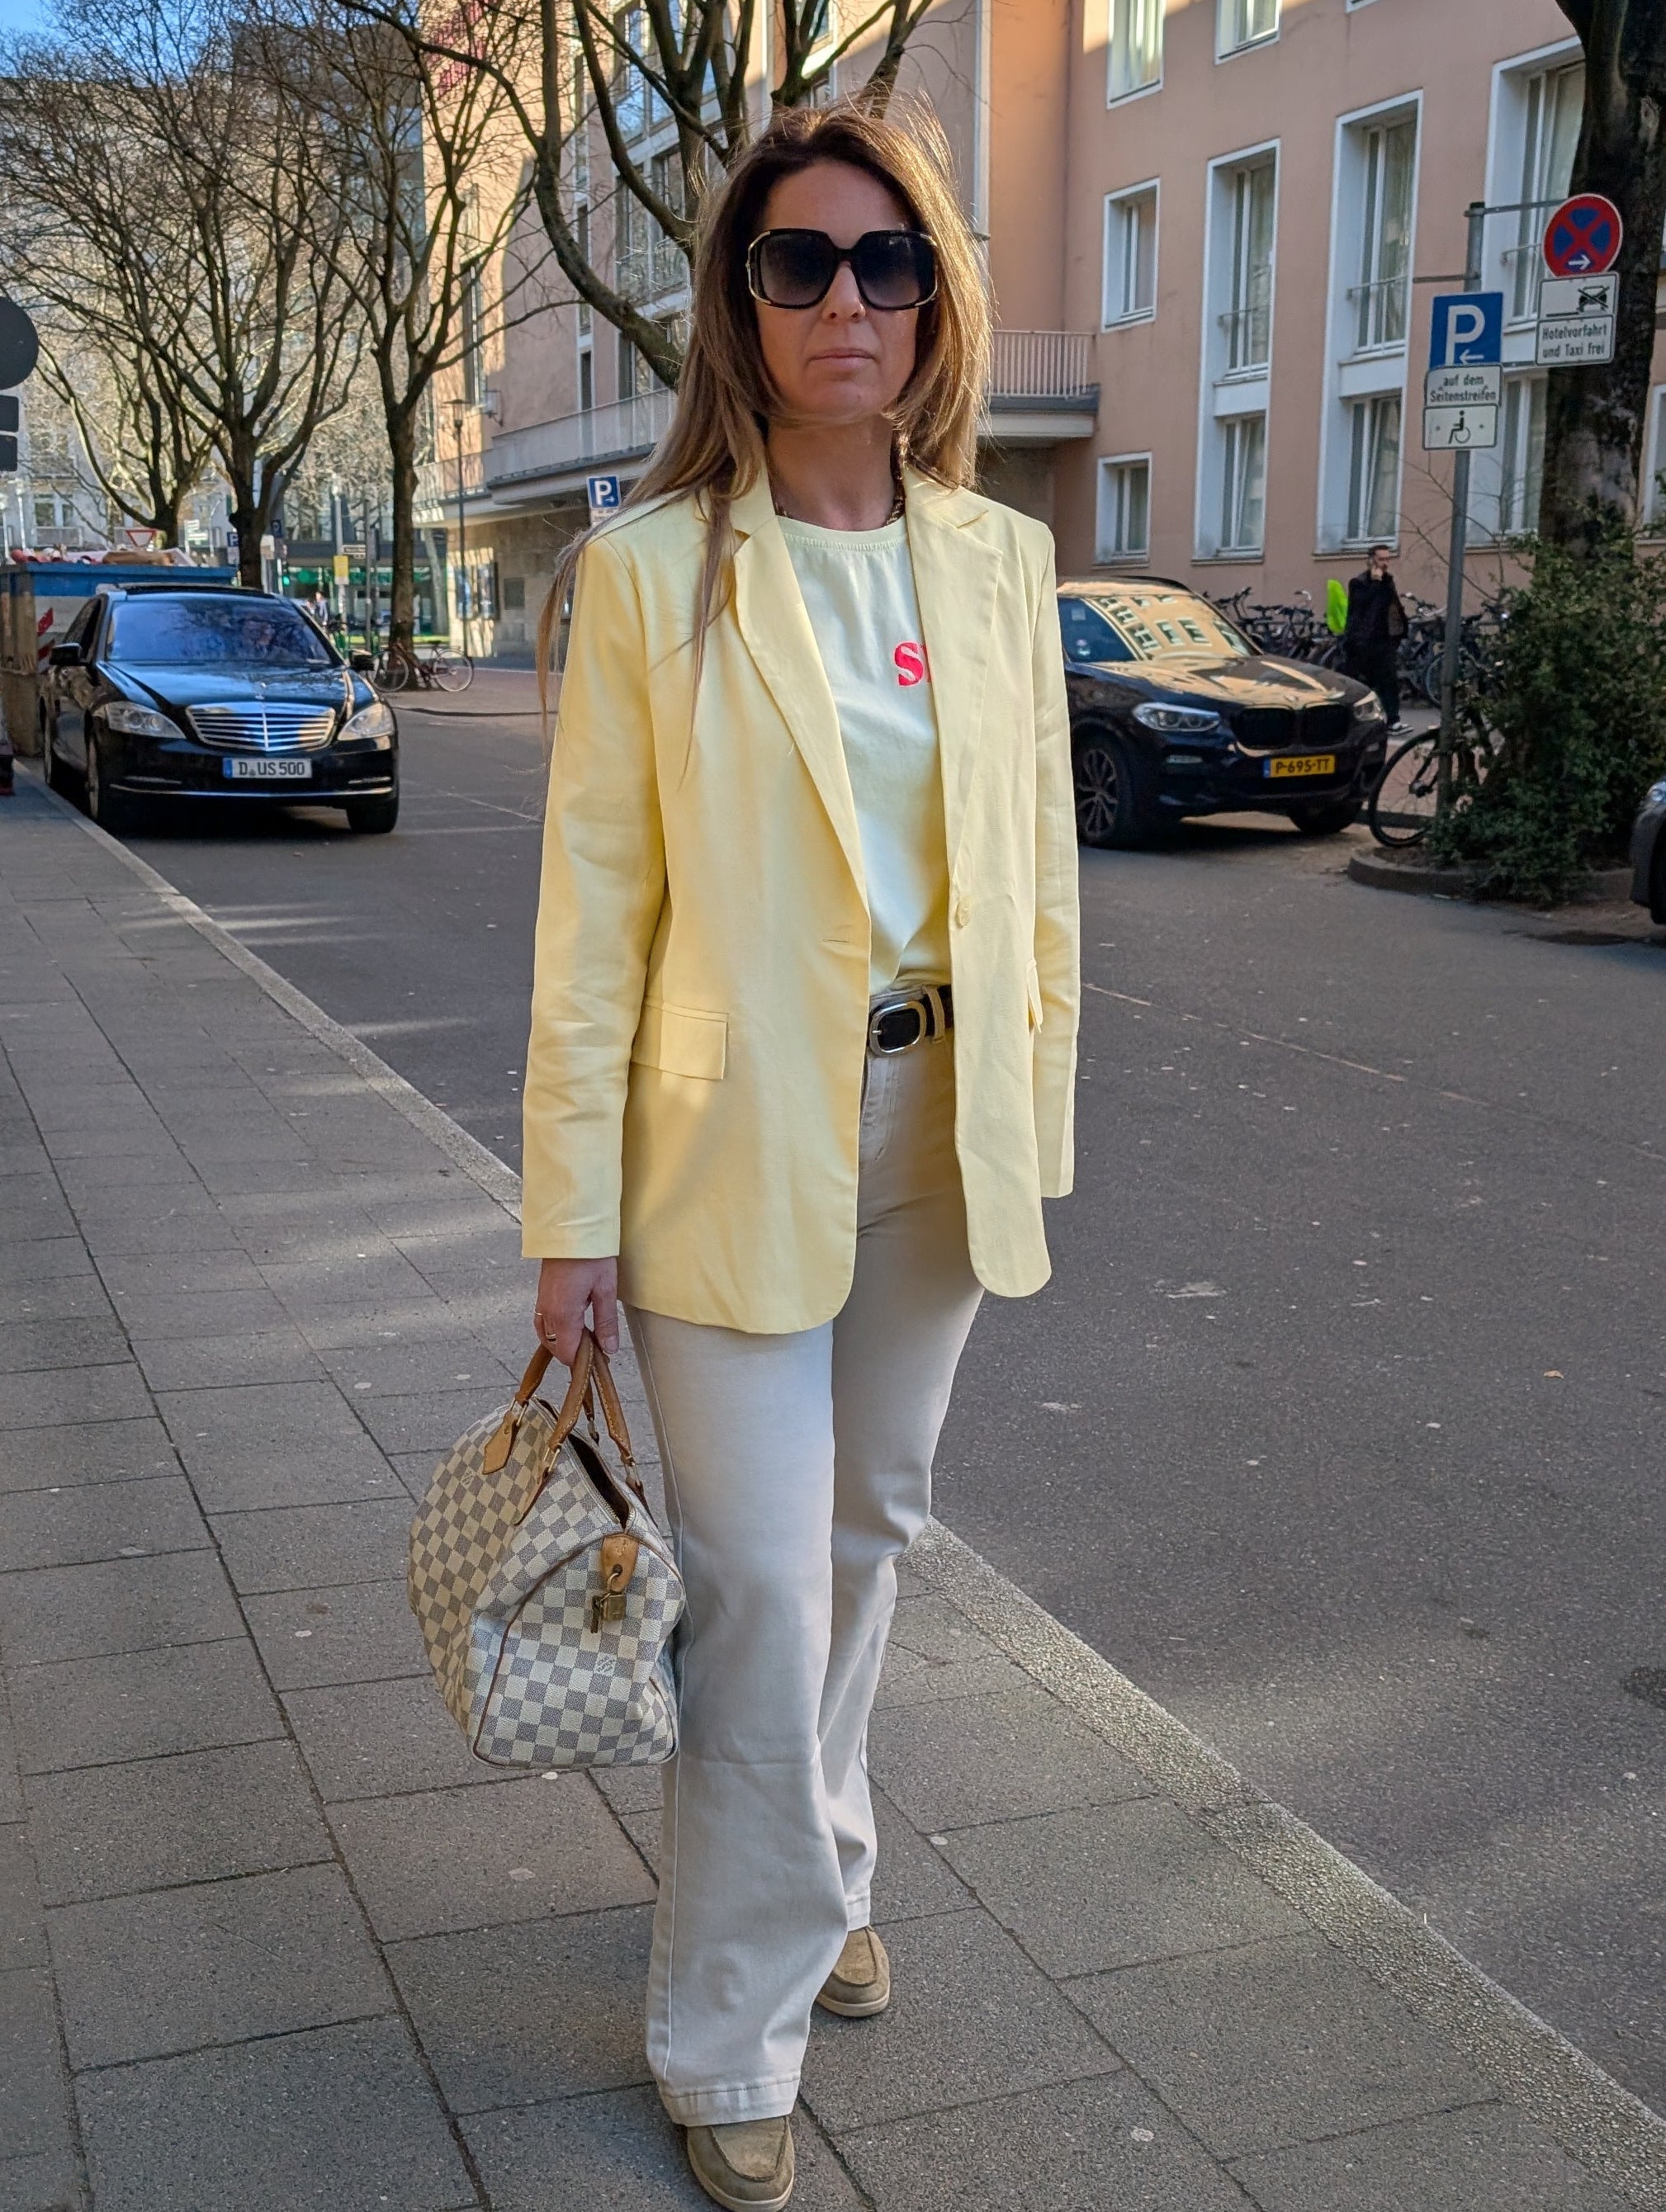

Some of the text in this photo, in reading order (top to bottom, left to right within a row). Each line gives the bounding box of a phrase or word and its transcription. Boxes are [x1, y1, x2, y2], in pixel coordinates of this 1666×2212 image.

[1446, 305, 1485, 365] P
[1542, 324, 1607, 340] Hotelvorfahrt
[1542, 342, 1605, 358] und Taxi frei
[1443, 374, 1484, 386] auf dem
[1430, 389, 1496, 403] Seitenstreifen
[594, 480, 612, 505] P
[238, 761, 248, 776] D
[278, 761, 305, 776] 500
[1276, 759, 1331, 774] P-695-TT
